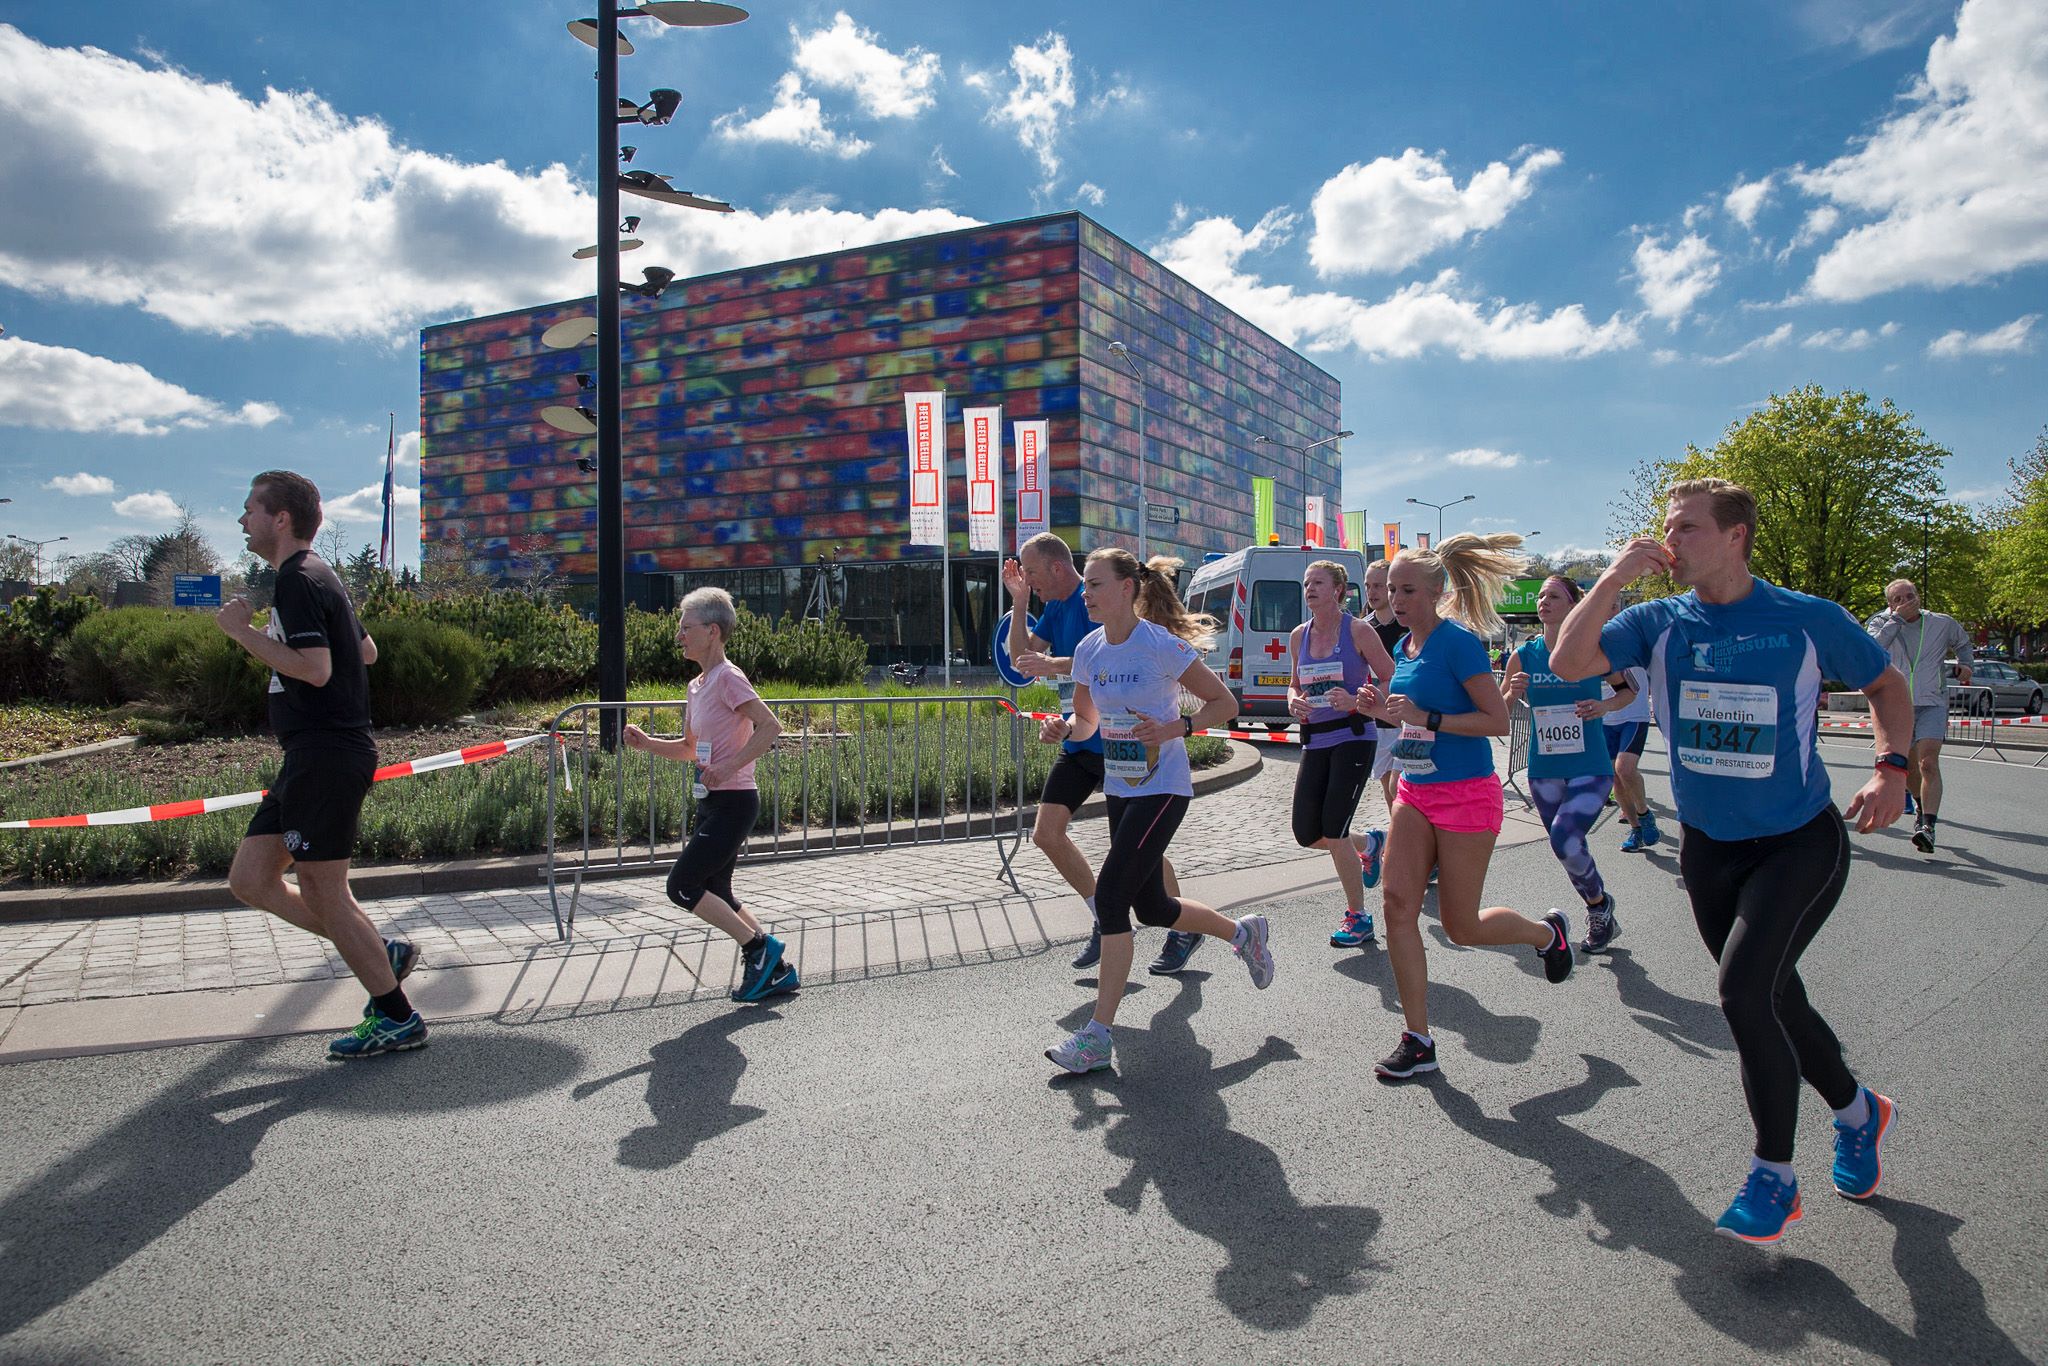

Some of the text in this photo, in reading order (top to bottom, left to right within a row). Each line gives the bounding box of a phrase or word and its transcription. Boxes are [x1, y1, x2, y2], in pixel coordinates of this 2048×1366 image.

[1504, 592, 1539, 604] dia Pa
[1093, 673, 1140, 686] POLITIE
[1698, 708, 1754, 723] Valentijn
[1538, 725, 1580, 742] 14068
[1690, 722, 1760, 753] 1347
[1716, 758, 1771, 769] PRESTATIELOOP
